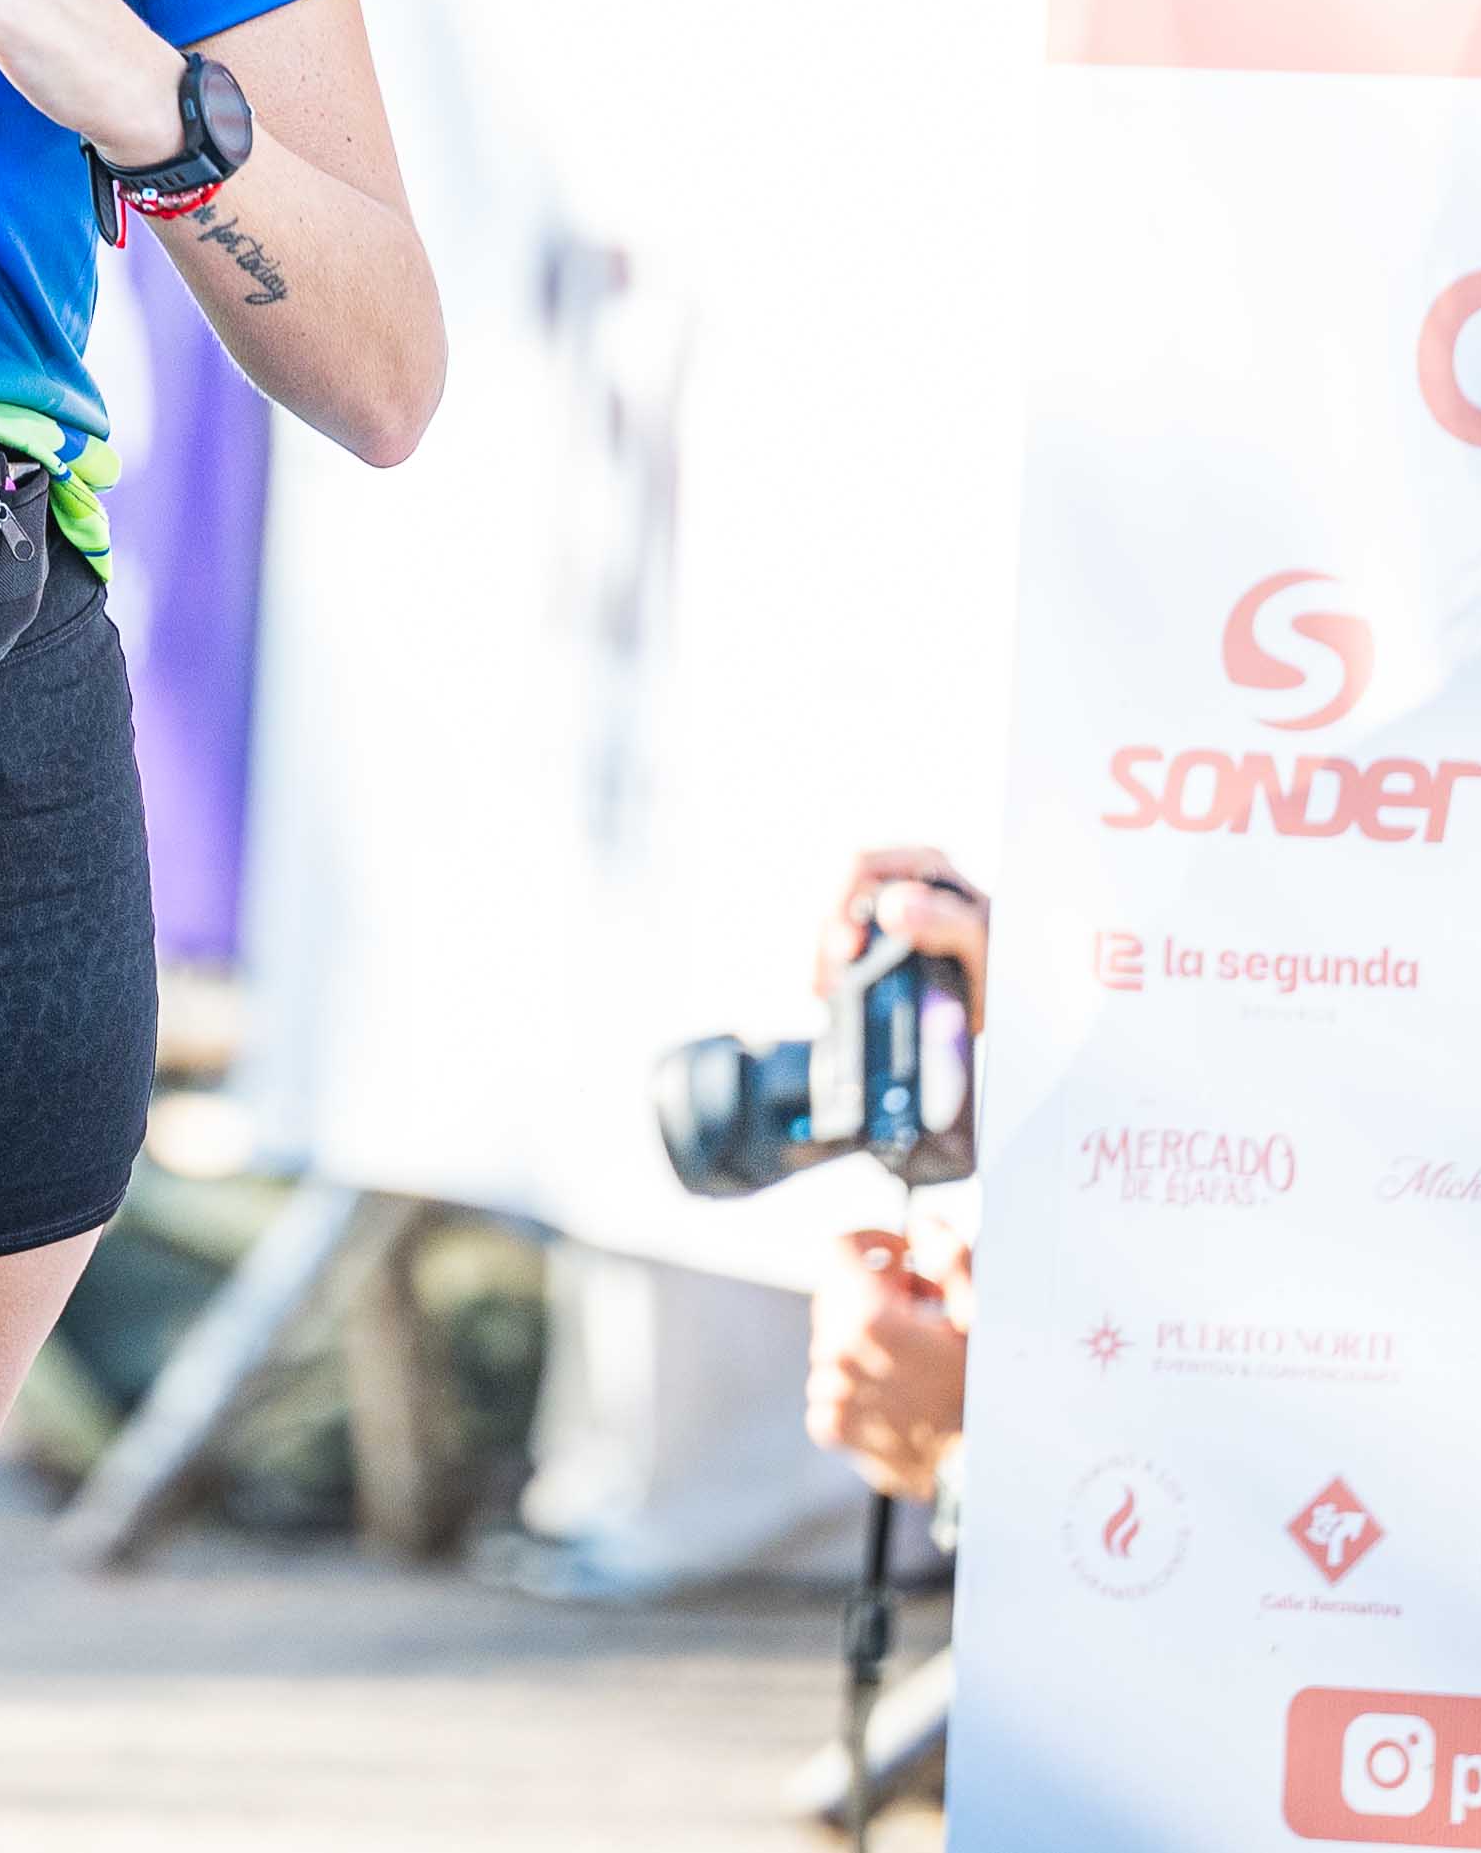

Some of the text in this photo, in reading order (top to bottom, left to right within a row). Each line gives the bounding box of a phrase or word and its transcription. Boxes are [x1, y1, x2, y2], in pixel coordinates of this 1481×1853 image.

[1162, 934, 1420, 994] la segunda
[1080, 1126, 1298, 1192] MERCADO
